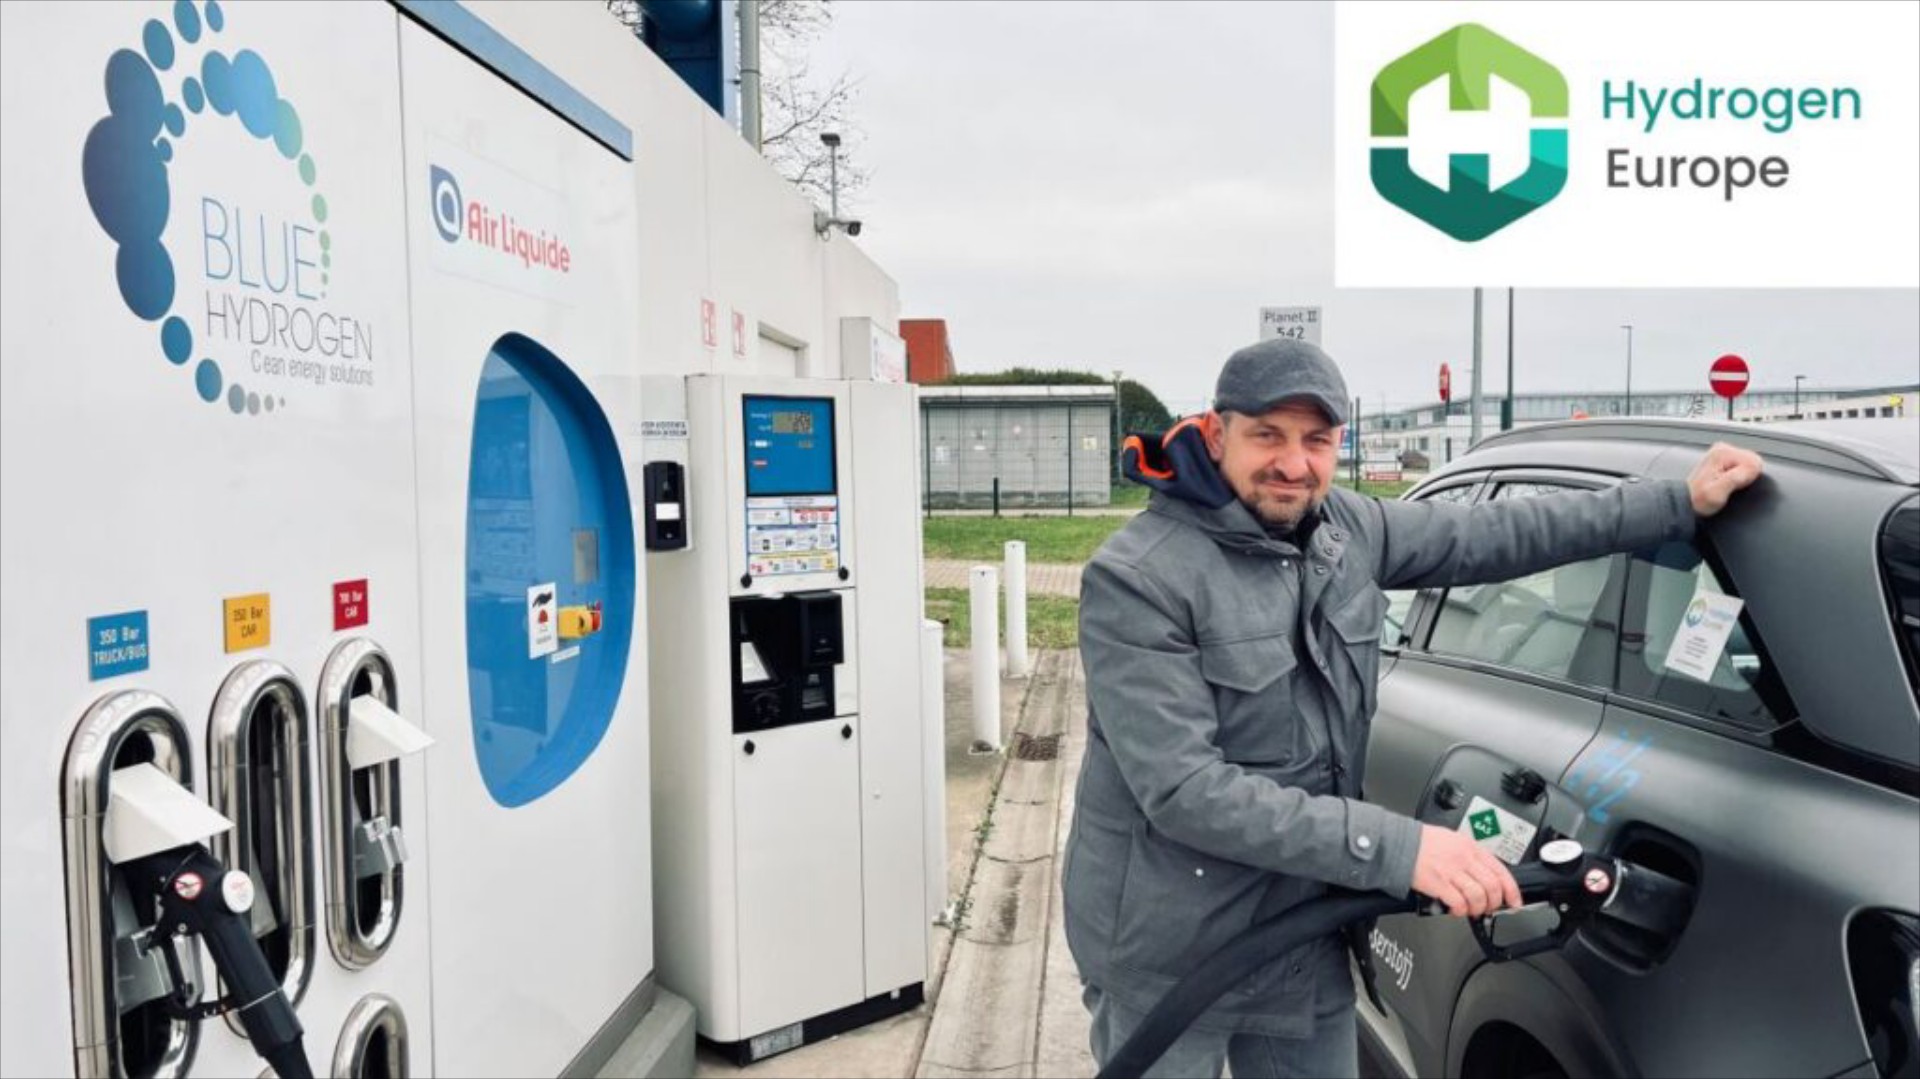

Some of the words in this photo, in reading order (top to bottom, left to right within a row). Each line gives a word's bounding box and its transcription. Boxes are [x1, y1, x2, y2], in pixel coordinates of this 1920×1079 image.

[202, 197, 319, 301] BLUE
[468, 201, 498, 248] Air
[501, 213, 571, 273] Liquide
[205, 290, 373, 362] HYDROGEN
[1264, 310, 1304, 323] Planet
[250, 349, 286, 377] Cean
[289, 357, 327, 385] energy
[330, 364, 374, 387] solutions
[250, 606, 264, 619] Bar
[122, 626, 140, 642] Bar
[241, 623, 257, 638] CAR
[94, 643, 147, 667] TRUCK/BUS
